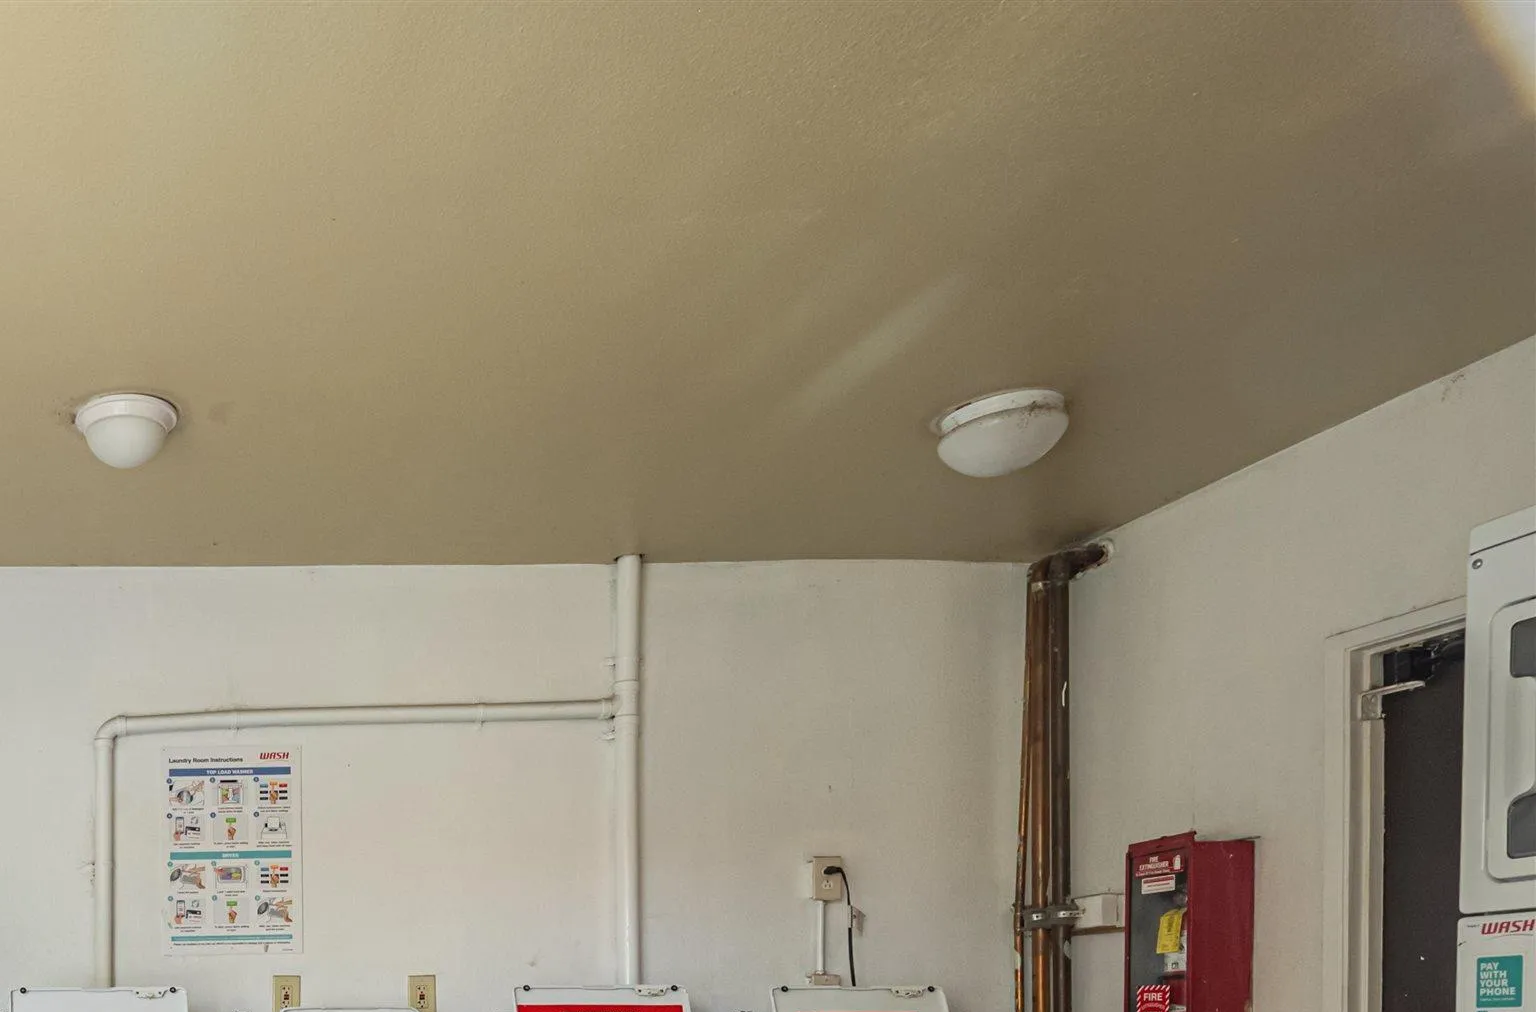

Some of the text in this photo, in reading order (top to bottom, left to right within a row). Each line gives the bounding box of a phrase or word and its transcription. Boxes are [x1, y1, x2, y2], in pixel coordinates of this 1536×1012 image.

[1139, 861, 1169, 870] EXTINGUISHER
[1481, 919, 1536, 935] WASH
[1480, 962, 1499, 970] PAY
[1480, 970, 1506, 979] WITH
[1480, 979, 1508, 987] YOUR
[1480, 987, 1516, 996] PHONE
[1143, 992, 1163, 1001] FIRE
